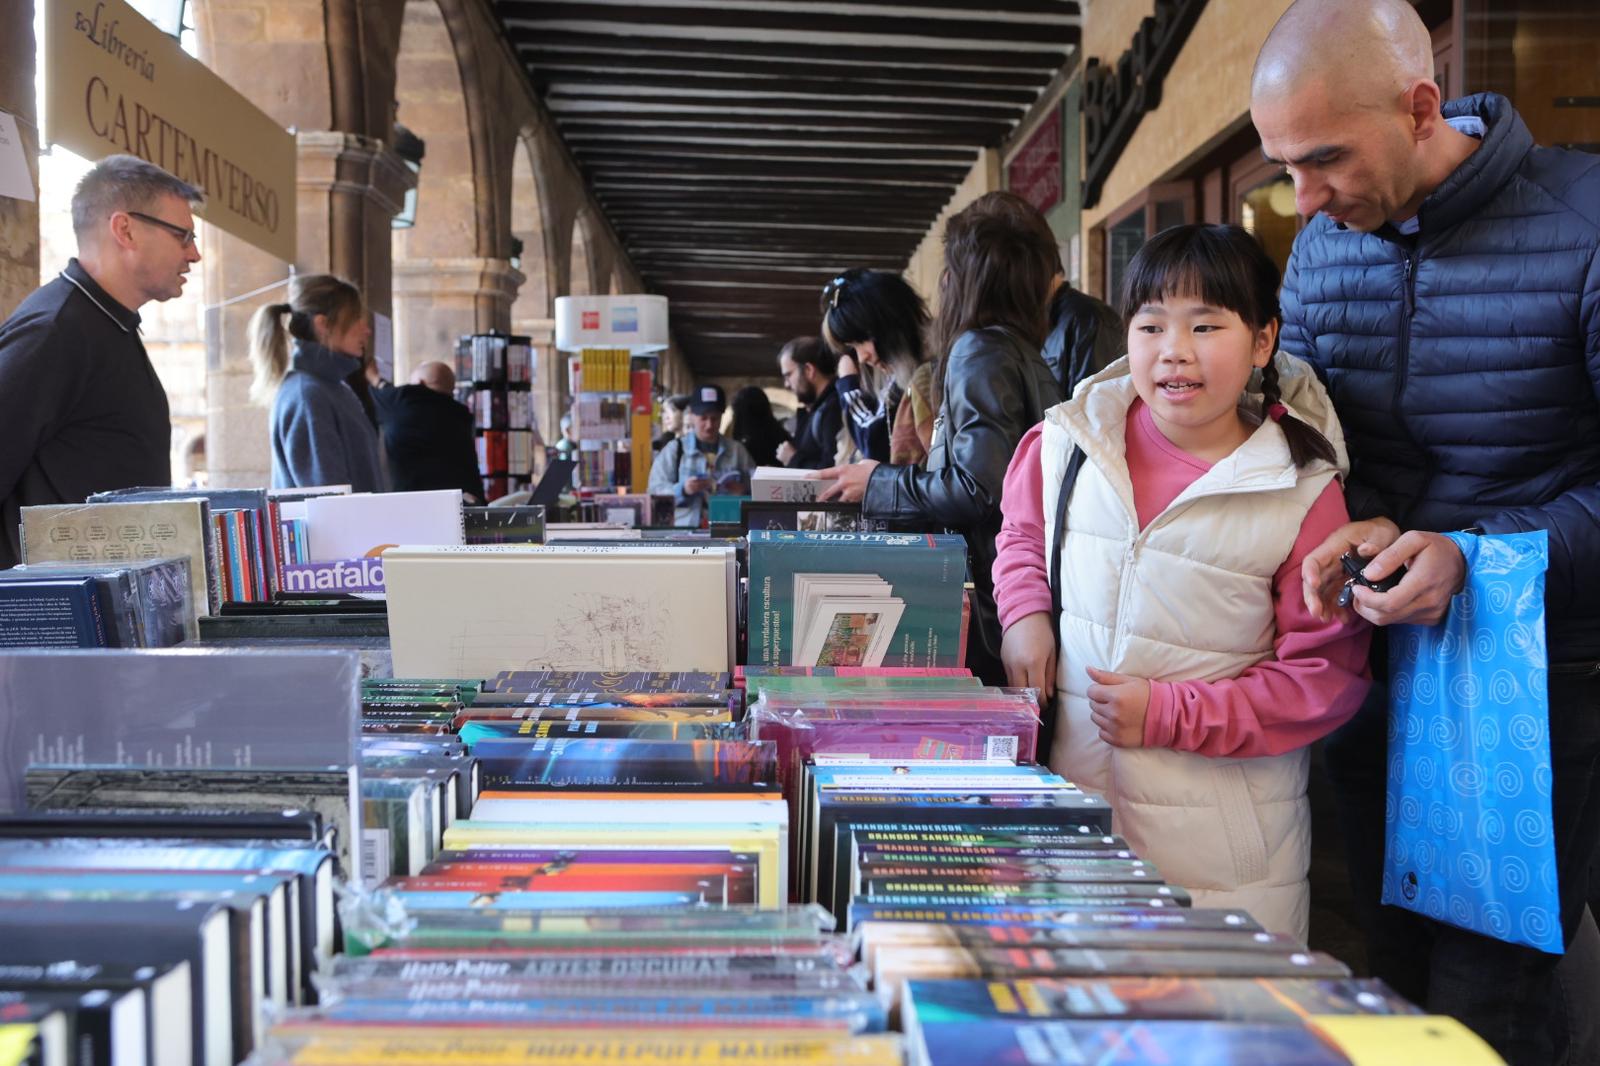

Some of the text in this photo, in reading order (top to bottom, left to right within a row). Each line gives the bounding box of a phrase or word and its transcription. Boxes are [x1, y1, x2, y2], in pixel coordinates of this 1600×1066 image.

[286, 560, 385, 591] mafald
[891, 796, 954, 804] SANDERSON
[849, 823, 898, 831] BRANDON
[901, 824, 962, 832] SANDERSON
[868, 833, 984, 842] BRANDON SANDERSON
[876, 843, 995, 854] BRANDON SANDERSON
[883, 854, 1006, 864] BRANDON SANDERSON
[872, 867, 1001, 877] BRANDON SANDERSON
[886, 883, 1020, 893] BRANDON SANDERSON
[867, 896, 927, 904] BRANDON
[931, 896, 1006, 905] SANDERSON
[873, 910, 946, 920] BRANDON
